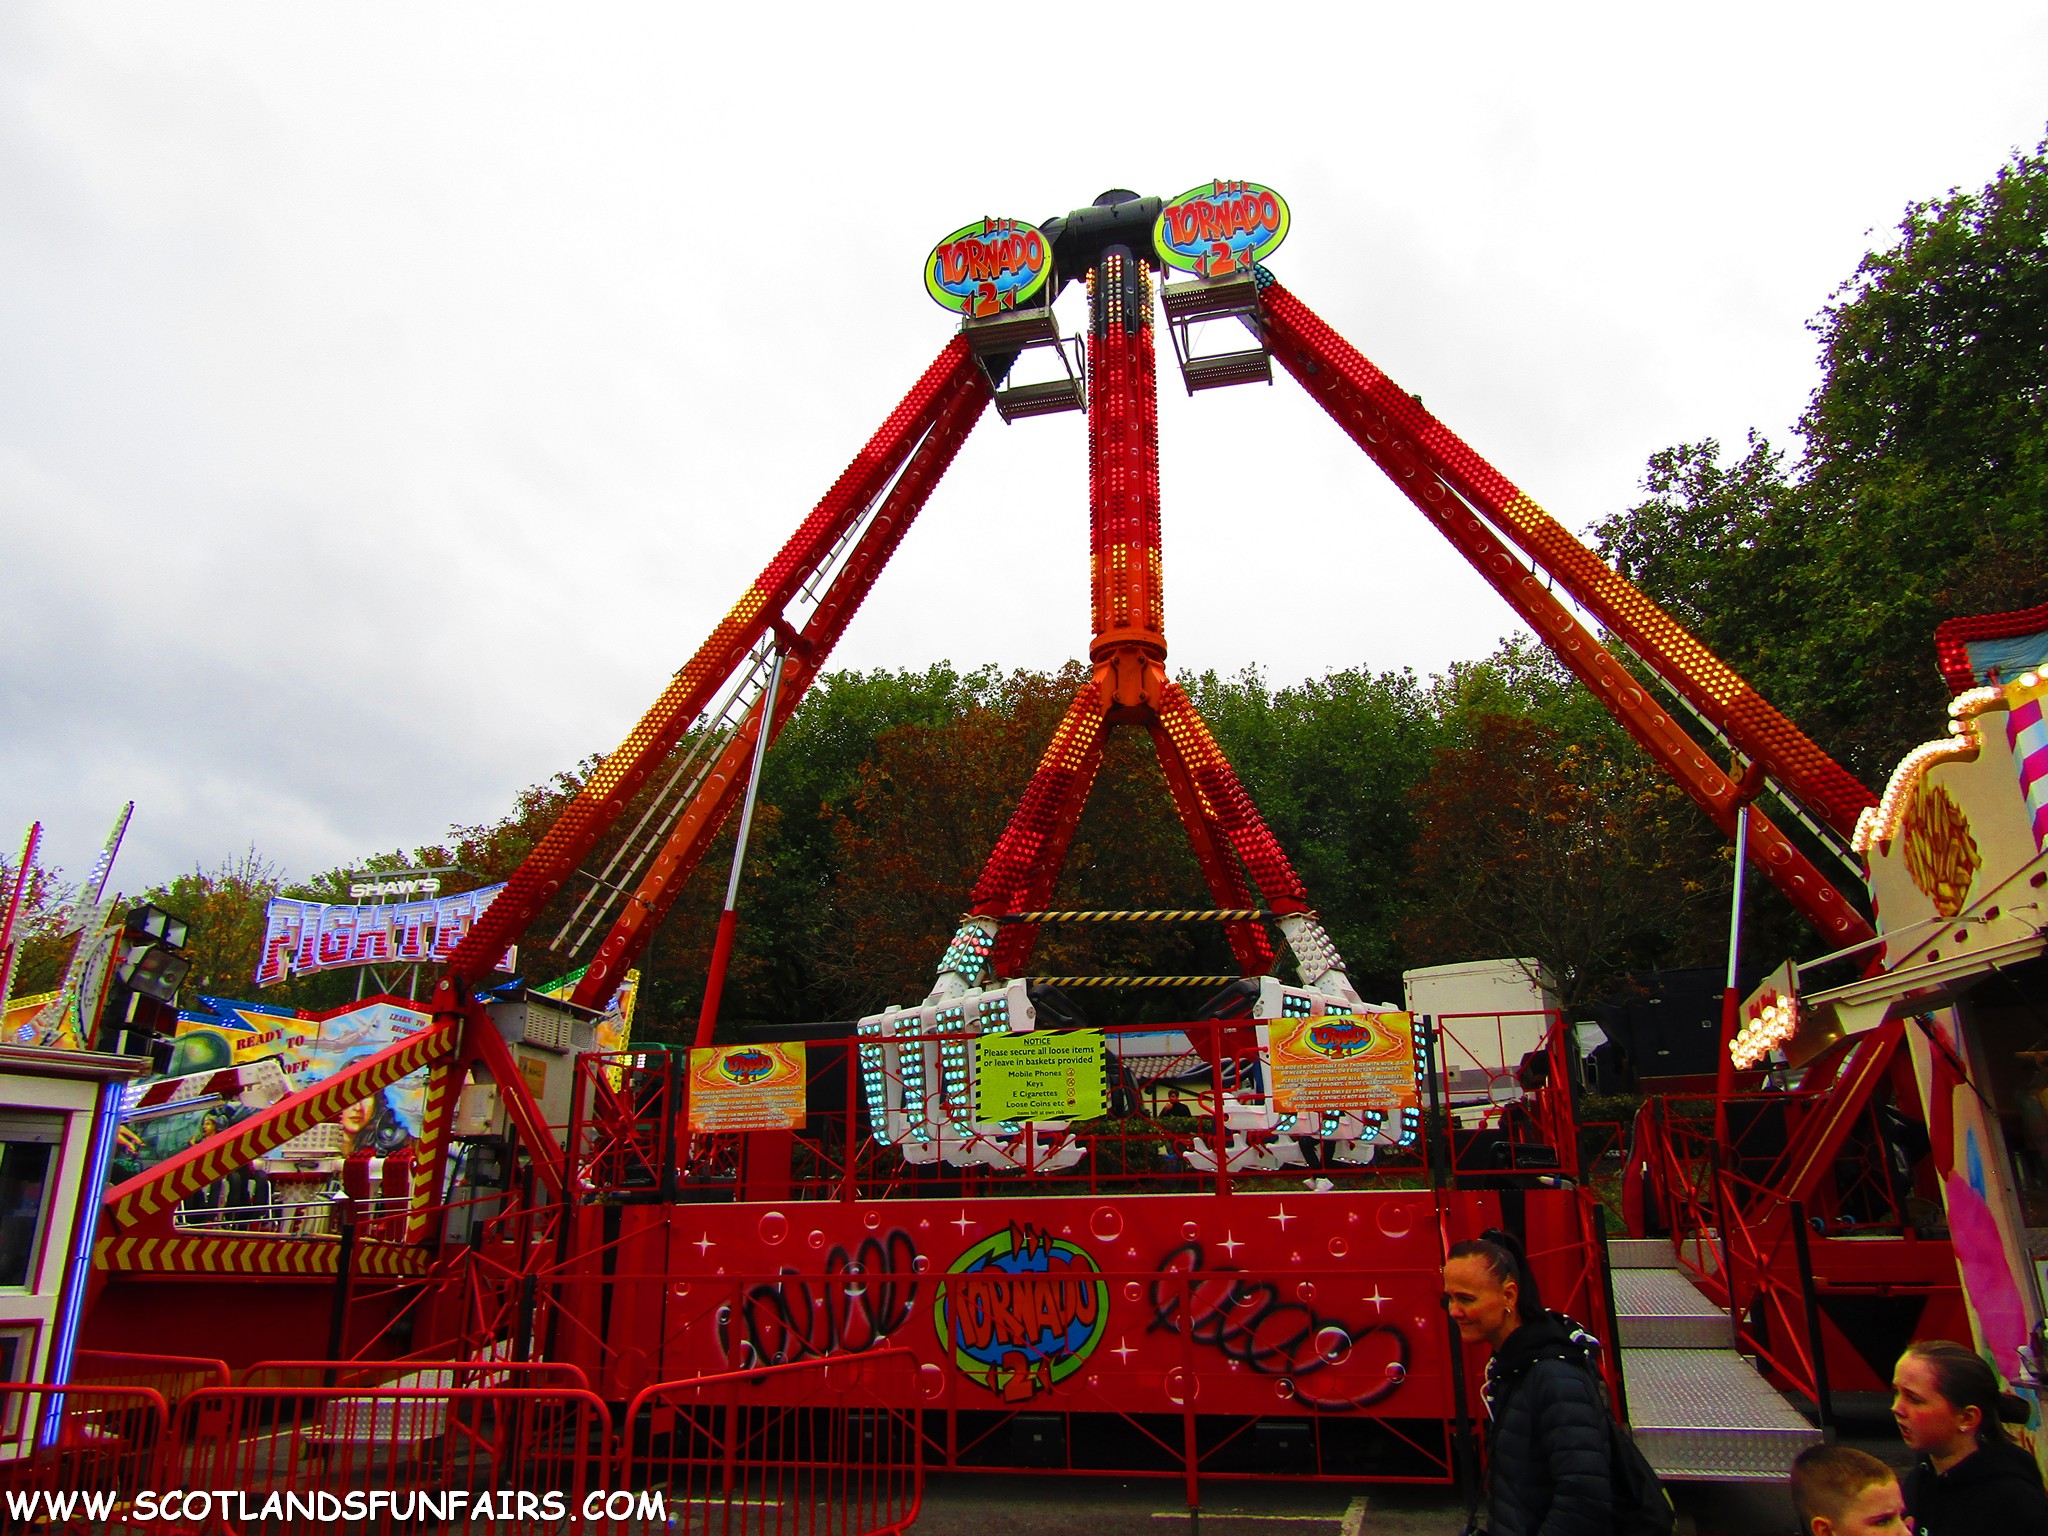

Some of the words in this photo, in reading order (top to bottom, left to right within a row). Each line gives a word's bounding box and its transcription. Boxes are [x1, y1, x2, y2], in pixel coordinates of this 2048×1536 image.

[1164, 191, 1279, 246] TORNADO
[937, 230, 1043, 284] TORNADO
[1209, 242, 1236, 277] 2
[976, 282, 1000, 318] 2
[350, 878, 440, 898] SHAW'S
[236, 1028, 284, 1050] READY
[286, 1035, 305, 1049] TO
[1023, 1038, 1051, 1046] NOTICE
[1311, 1026, 1371, 1044] TORNADO
[984, 1048, 1008, 1056] Please
[1072, 1046, 1094, 1054] items
[1331, 1044, 1344, 1059] 2
[725, 1055, 773, 1073] TORNADO
[994, 1058, 1014, 1066] leave
[1026, 1057, 1056, 1066] baskets
[1058, 1056, 1092, 1066] provided
[740, 1072, 750, 1085] 2
[1020, 1090, 1058, 1098] Cigarettes
[952, 1254, 1099, 1349] TORNADO
[1002, 1351, 1033, 1403] 2
